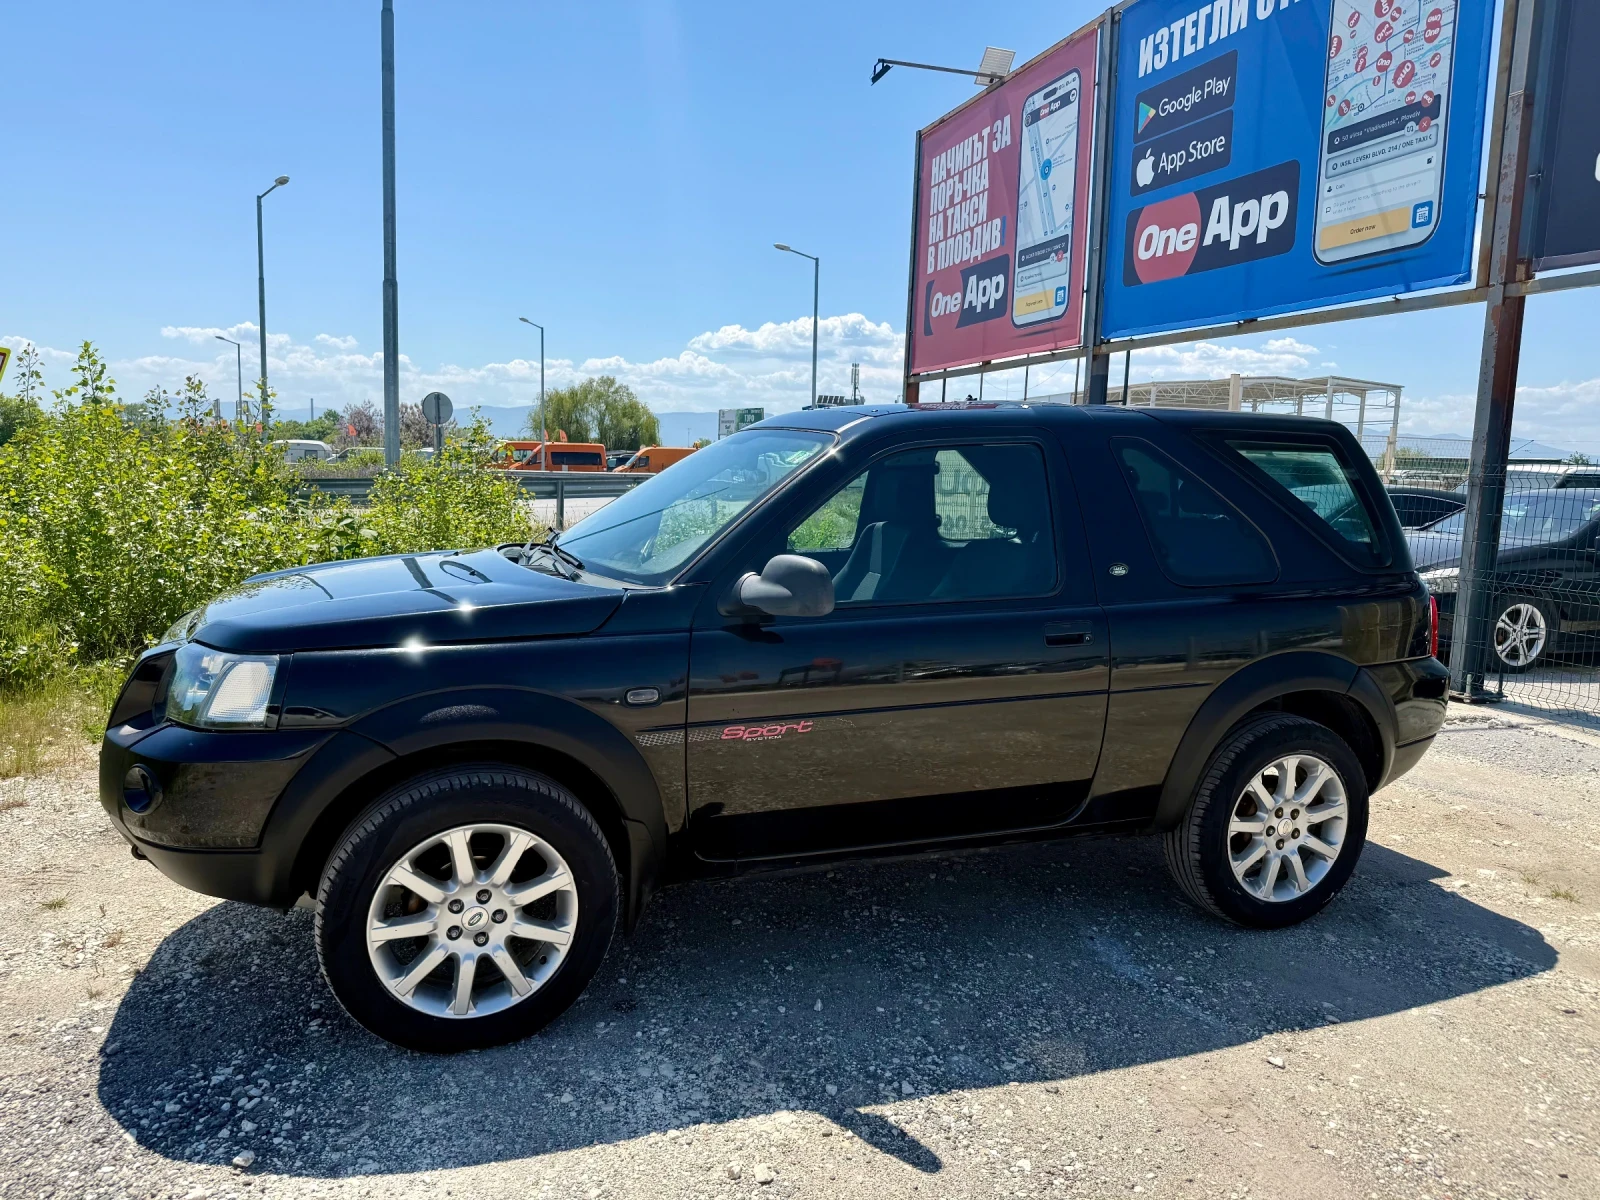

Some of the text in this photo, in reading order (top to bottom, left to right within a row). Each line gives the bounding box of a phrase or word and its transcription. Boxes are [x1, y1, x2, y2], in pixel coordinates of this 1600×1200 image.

[1381, 0, 1389, 14] On
[1350, 13, 1358, 27] One
[1138, 0, 1249, 78] ИЗТЕГЛИ
[1425, 28, 1440, 38] One
[1330, 37, 1338, 57] One
[1377, 58, 1391, 66] One
[1396, 62, 1411, 85] One
[1050, 101, 1061, 111] App
[1159, 76, 1231, 117] Google Play
[1400, 111, 1421, 122] Plovdiv
[931, 126, 991, 186] НАЧИНЪТ
[992, 114, 1011, 153] ЗА
[1158, 135, 1226, 175] App Store
[1353, 154, 1371, 164] LEVSKI
[1371, 148, 1387, 158] BLVD.
[1388, 145, 1398, 153] 214
[1402, 140, 1414, 149] ONE
[1415, 136, 1430, 145] TAXI
[930, 158, 989, 216] ПОРЪЧКА
[929, 190, 988, 246] НА ТАКСИ
[1137, 190, 1289, 261] One App
[1350, 226, 1365, 235] Order
[927, 245, 935, 275] В
[937, 215, 1007, 272] ПЛОВДИВ!
[931, 273, 1005, 318] One App
[721, 720, 813, 740] Sport
